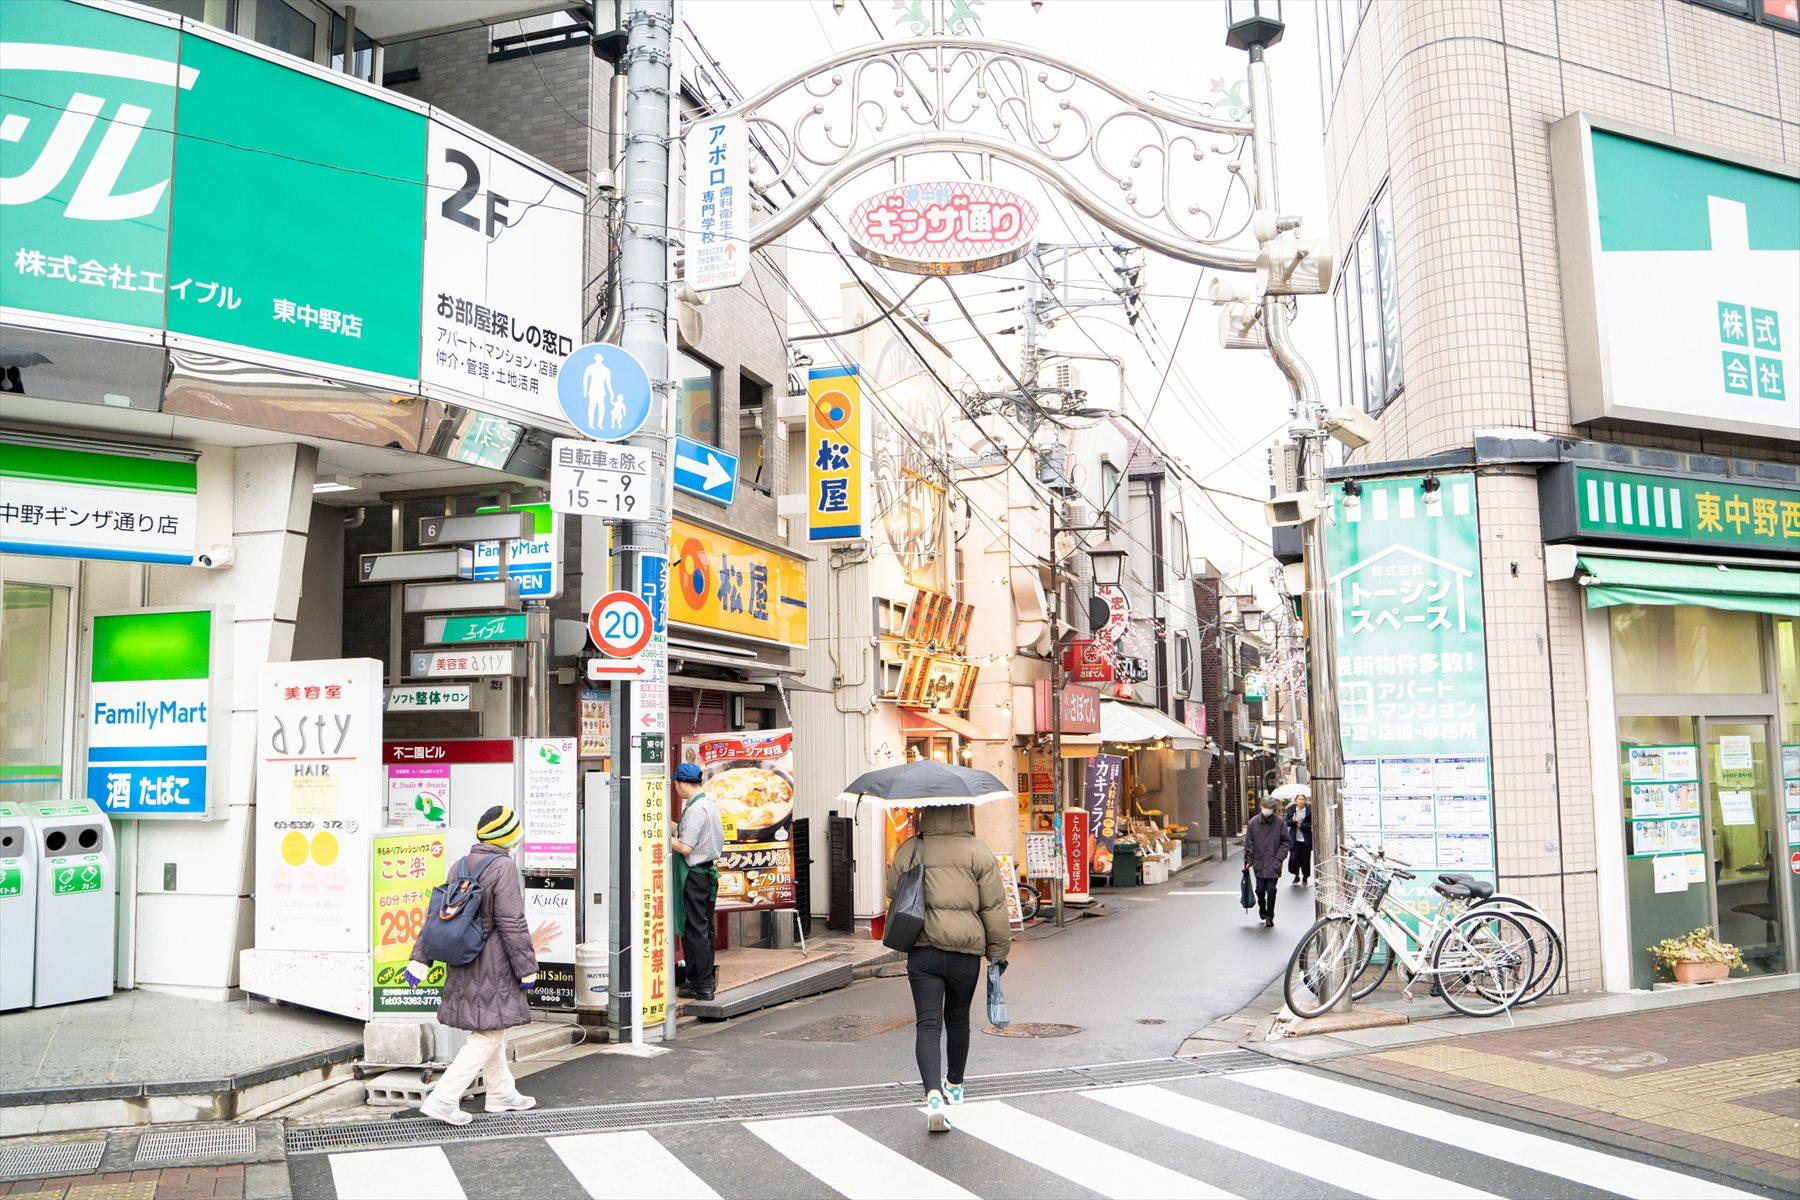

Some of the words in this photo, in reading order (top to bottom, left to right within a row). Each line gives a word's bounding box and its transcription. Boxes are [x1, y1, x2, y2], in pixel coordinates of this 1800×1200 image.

[708, 125, 726, 186] アポロ
[441, 148, 510, 239] 2F
[701, 191, 716, 244] 専門学校
[720, 186, 733, 242] 歯科衛生士
[866, 196, 1022, 244] ギンザ通り
[271, 298, 363, 339] 東中野店
[437, 292, 573, 356] お部屋探しの窓口
[436, 349, 540, 395] 仲介・管理・土地活用
[559, 446, 646, 472] 自転車を除く
[815, 439, 850, 512] 松屋
[0, 502, 179, 535] 中野ギンザ通り店
[428, 525, 436, 537] 6
[364, 563, 372, 573] 5
[717, 553, 768, 620] 松屋
[1352, 579, 1451, 606] トーシン
[605, 611, 639, 639] 20
[1351, 607, 1453, 634] スペース
[417, 657, 426, 671] 3
[436, 658, 468, 671] 美容室
[284, 684, 342, 700] 美容室
[392, 690, 468, 706] ソフト整体サロン
[1376, 680, 1454, 700] アパート
[94, 700, 207, 730] FamilyMart
[1376, 701, 1476, 720] マンション
[271, 714, 352, 756] asty
[562, 742, 572, 752] 6F
[393, 746, 446, 760] 不二園ビル
[294, 764, 330, 776] HAIR
[106, 772, 131, 809] 酒
[139, 775, 190, 806] たばこ
[1091, 761, 1109, 838] カキフライ
[1072, 815, 1081, 847] とんかつ
[382, 856, 427, 879] ここ楽
[544, 878, 555, 888] 5F
[380, 894, 400, 907] 60分
[532, 893, 569, 907] Kuku
[548, 970, 574, 981] Salon
